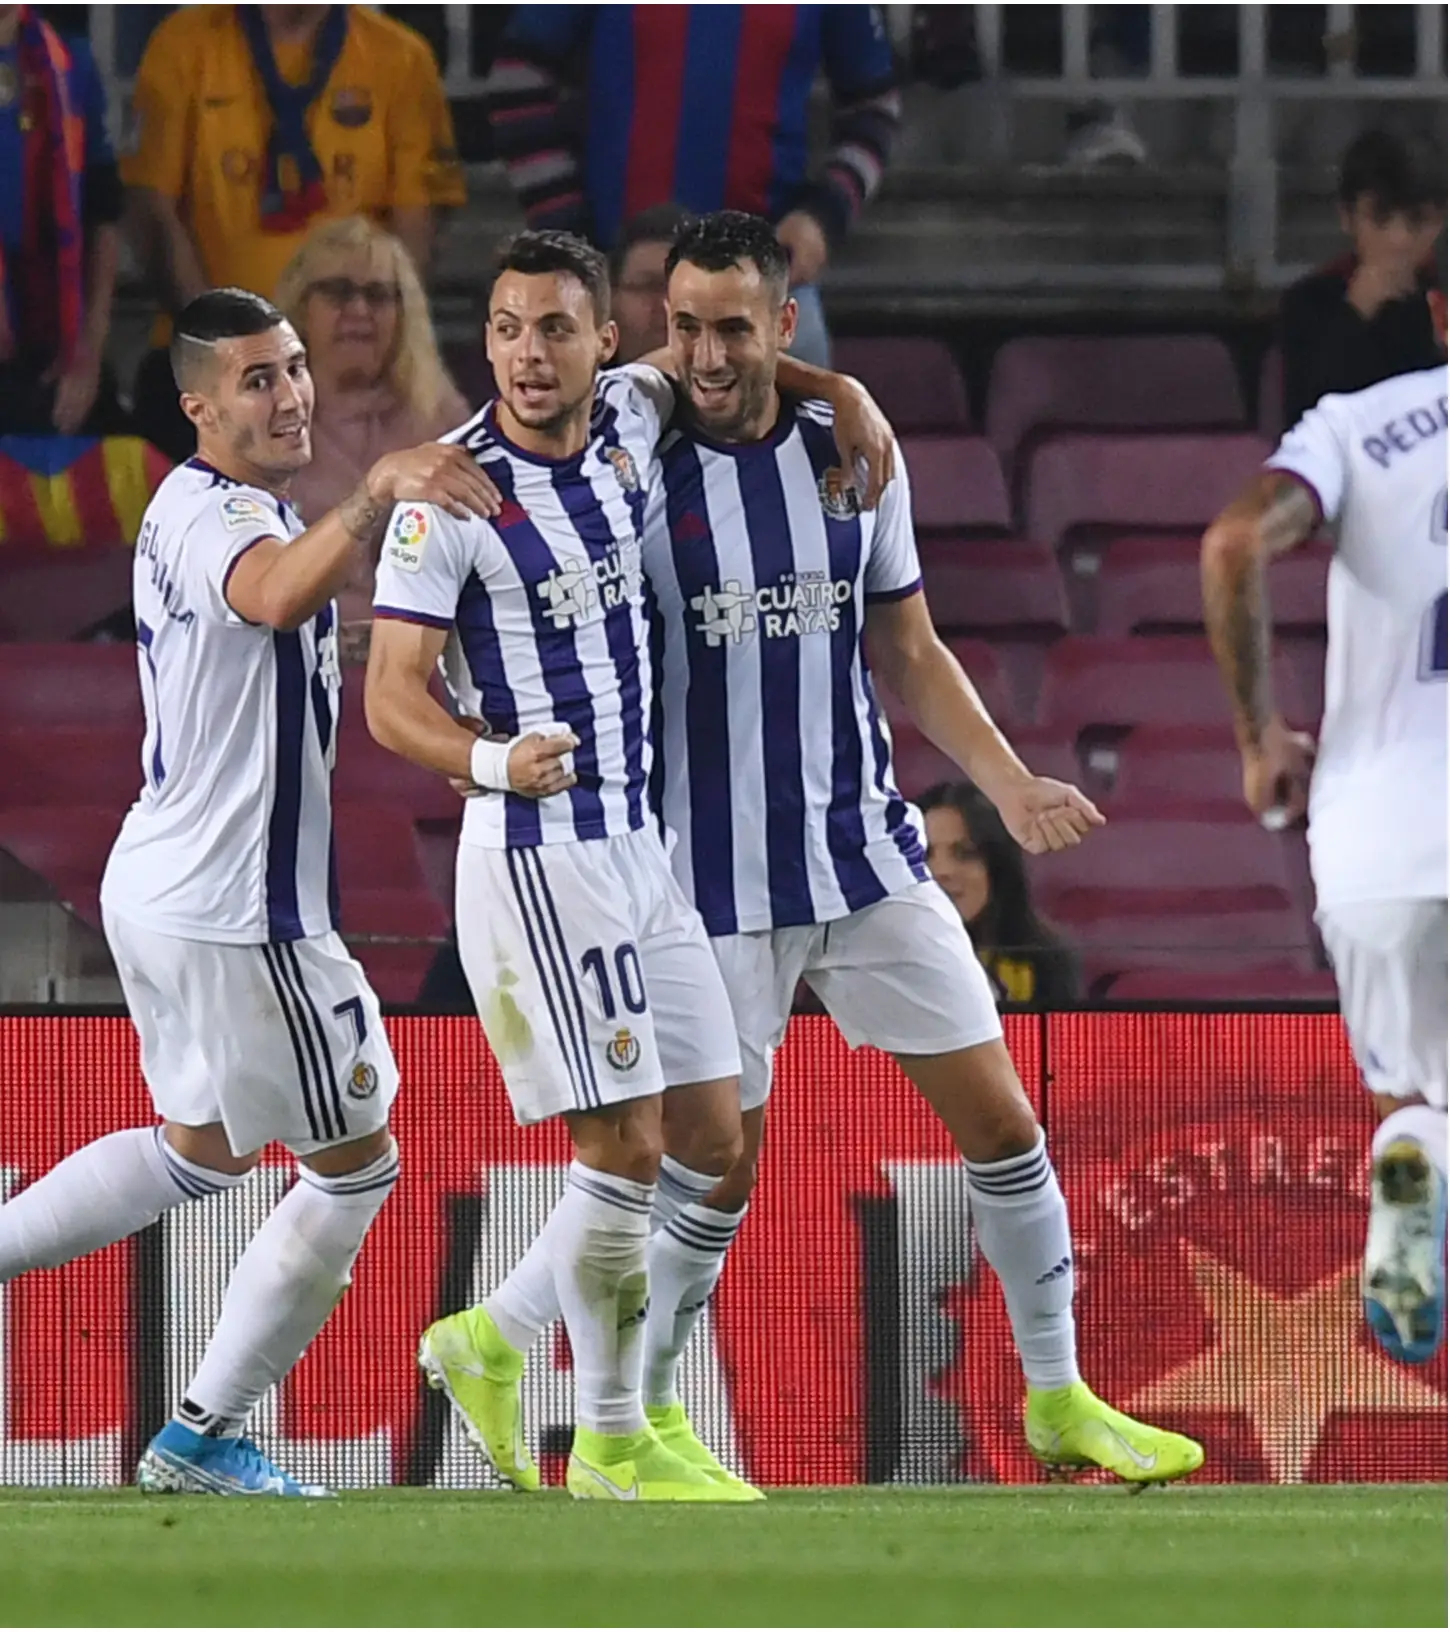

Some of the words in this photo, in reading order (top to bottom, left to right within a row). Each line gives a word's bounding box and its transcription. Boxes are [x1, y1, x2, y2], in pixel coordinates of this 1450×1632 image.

[755, 579, 852, 612] CUATRO
[765, 607, 841, 639] RAYAS
[580, 943, 647, 1021] 10
[332, 995, 367, 1060] 7
